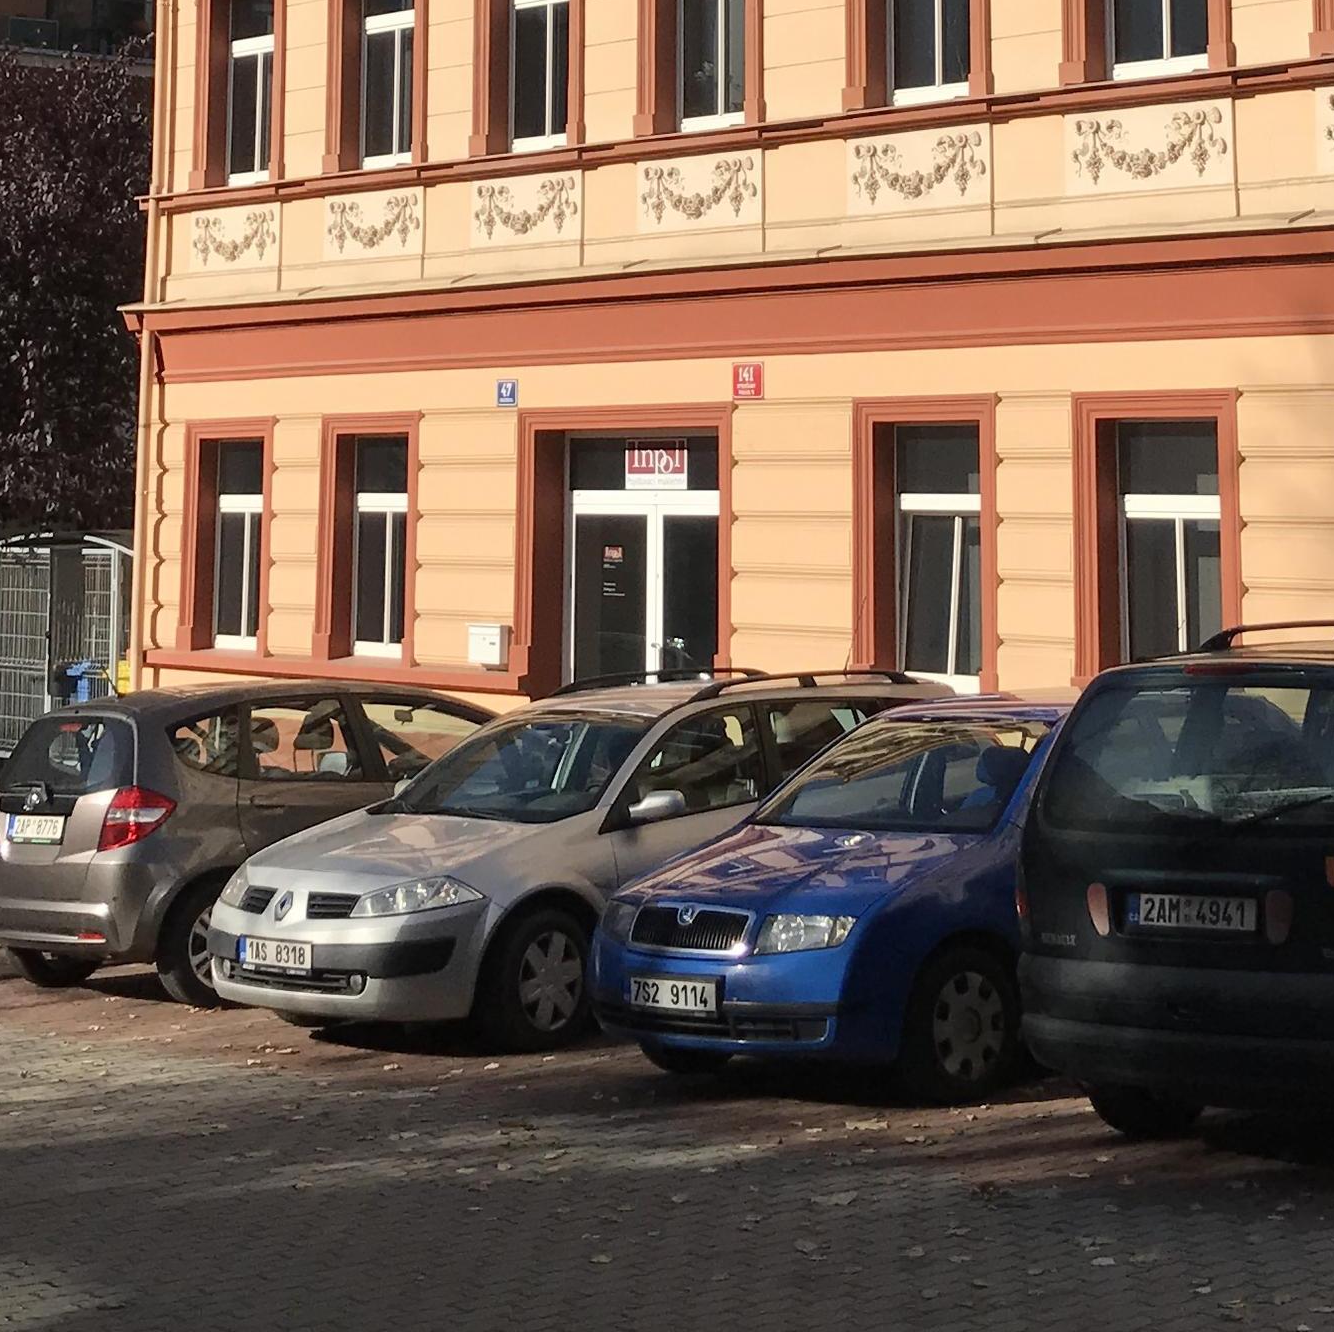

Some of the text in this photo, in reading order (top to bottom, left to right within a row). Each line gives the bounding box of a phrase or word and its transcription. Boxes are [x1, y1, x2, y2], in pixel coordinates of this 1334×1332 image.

[739, 367, 754, 381] 141
[501, 383, 512, 397] 47
[1143, 897, 1245, 928] 2AM 4941
[249, 941, 305, 965] 1AS 8318
[633, 980, 708, 1008] 7S2 9114
